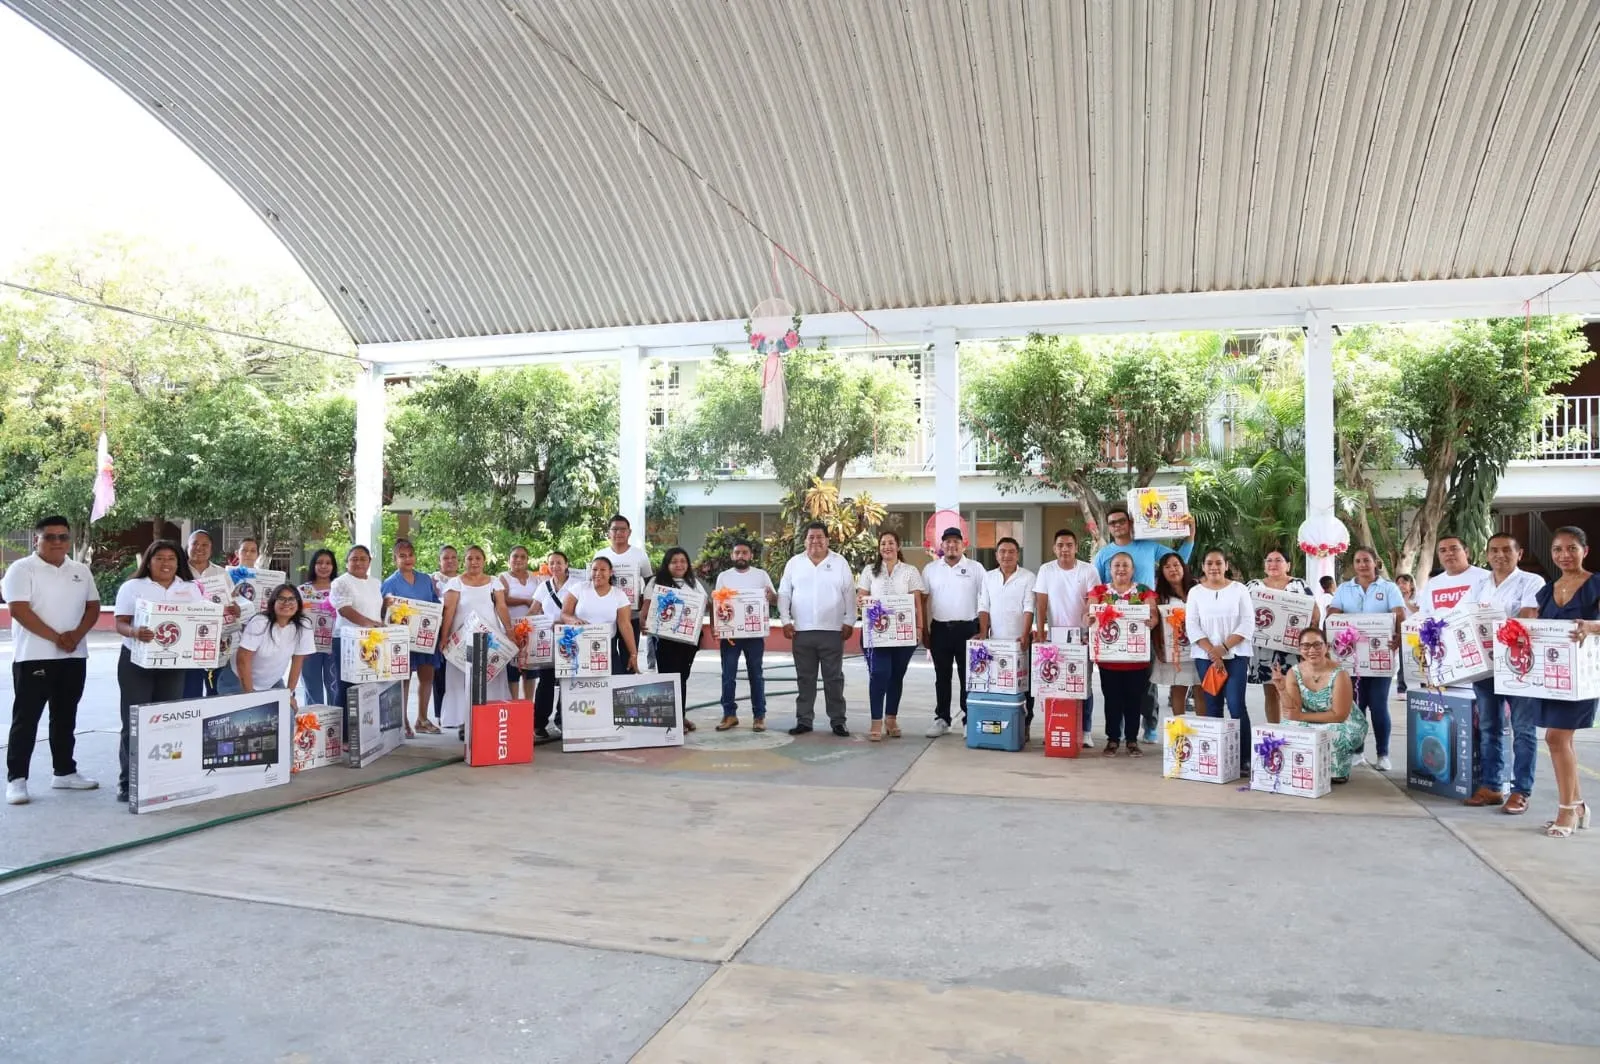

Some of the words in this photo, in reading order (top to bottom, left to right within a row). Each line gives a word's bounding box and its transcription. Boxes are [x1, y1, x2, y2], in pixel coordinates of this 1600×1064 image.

[1434, 590, 1466, 603] Levi's
[579, 680, 609, 689] SANSUI
[162, 709, 201, 722] SANSUI
[498, 708, 508, 760] aiwa
